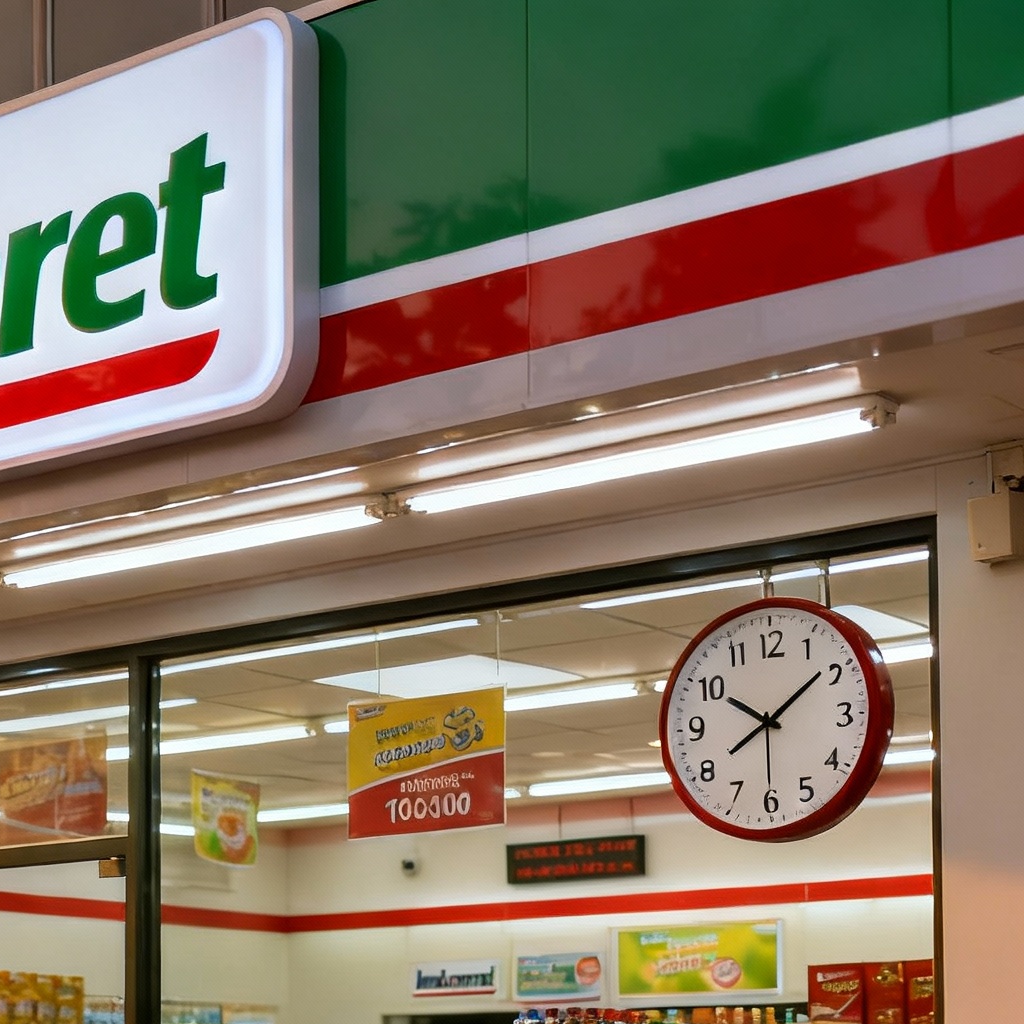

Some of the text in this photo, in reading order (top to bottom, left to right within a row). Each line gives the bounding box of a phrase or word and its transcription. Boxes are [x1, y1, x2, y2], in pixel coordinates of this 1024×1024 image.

[728, 640, 746, 668] 11
[759, 630, 786, 659] 12
[801, 638, 811, 660] 1
[698, 674, 725, 702] 10
[836, 701, 854, 728] 3
[688, 716, 705, 741] 9
[700, 759, 716, 782] 8
[824, 747, 839, 771] 4
[728, 780, 745, 809] 7
[763, 789, 779, 814] 6
[799, 776, 815, 803] 5
